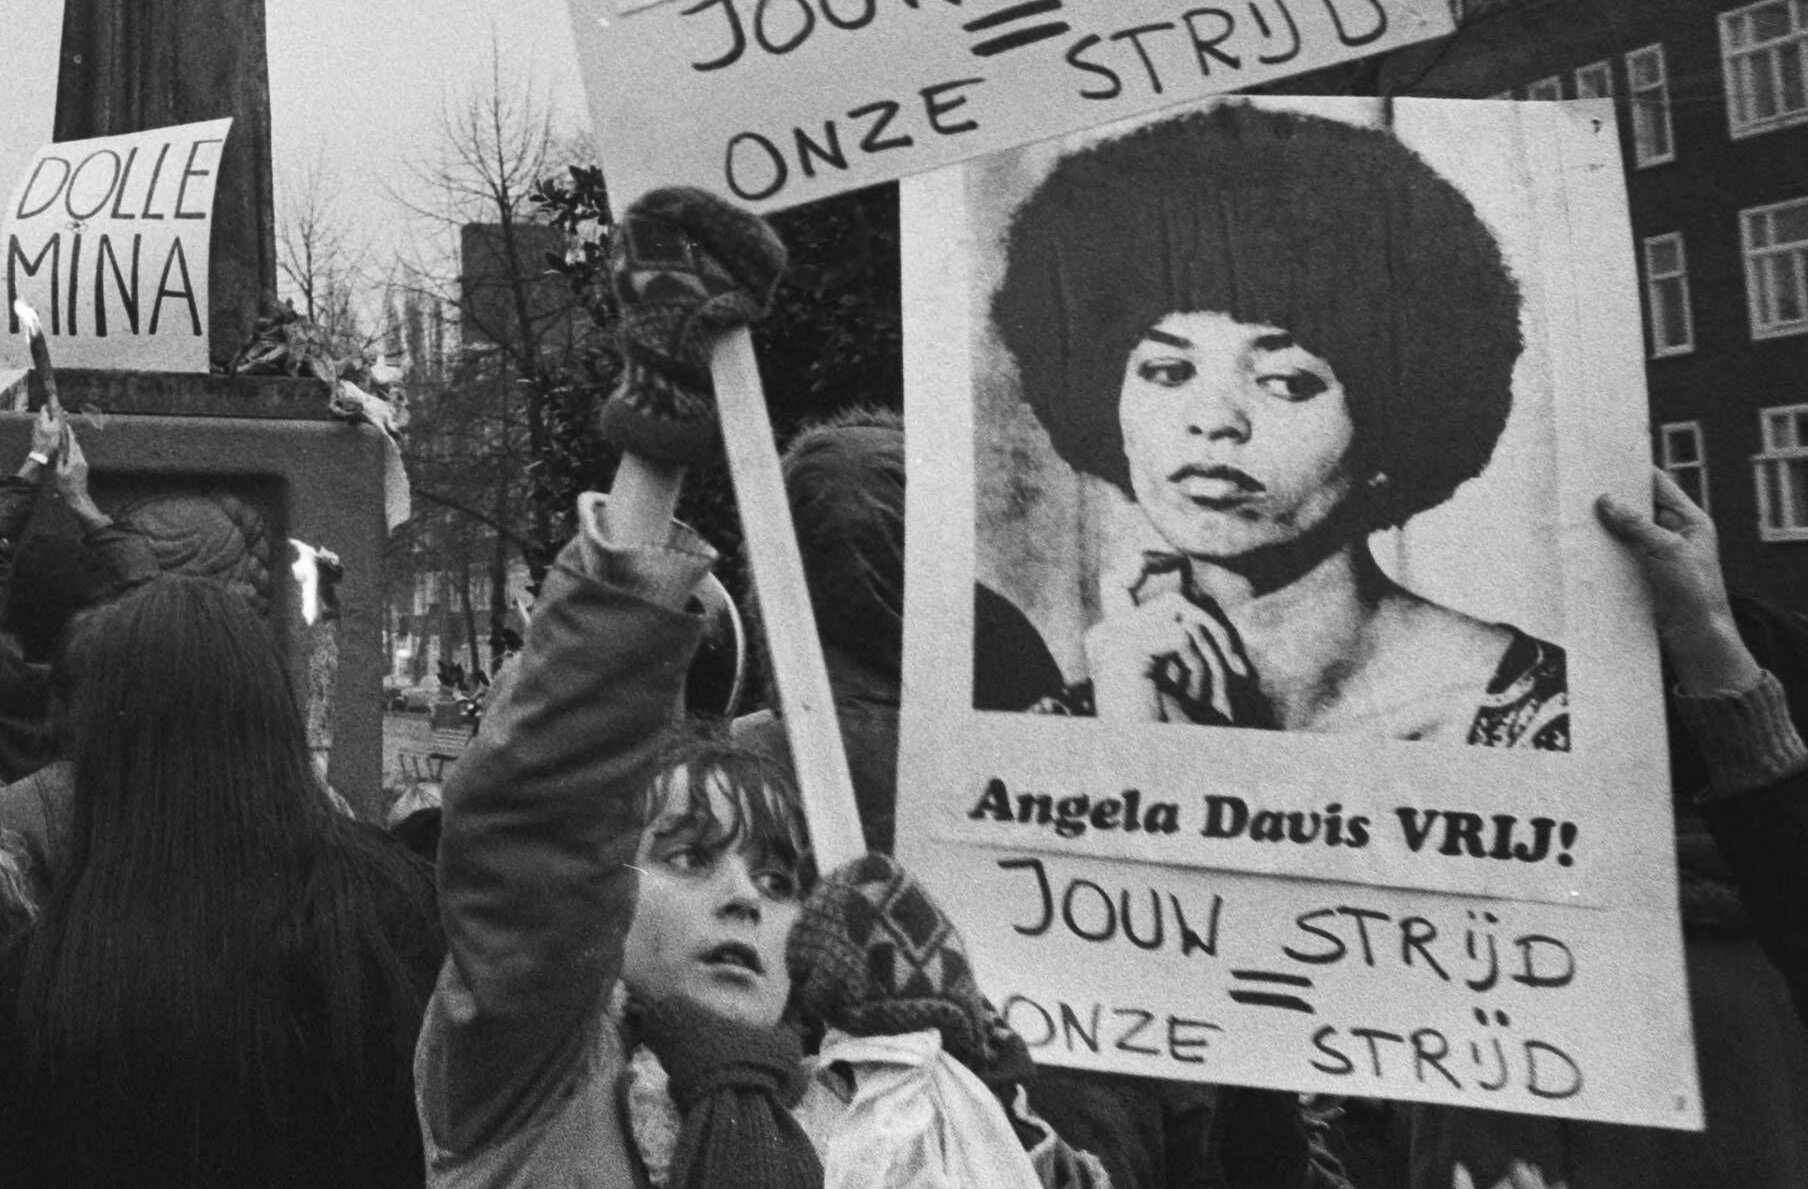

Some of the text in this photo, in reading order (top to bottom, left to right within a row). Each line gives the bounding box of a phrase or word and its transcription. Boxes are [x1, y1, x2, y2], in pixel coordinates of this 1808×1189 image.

[16, 139, 223, 221] DOLLE
[724, 77, 986, 201] ONZE
[967, 778, 1578, 869] Angela Davis VRIJ!
[998, 857, 1222, 956] JOUW
[1001, 994, 1224, 1064] ONZE
